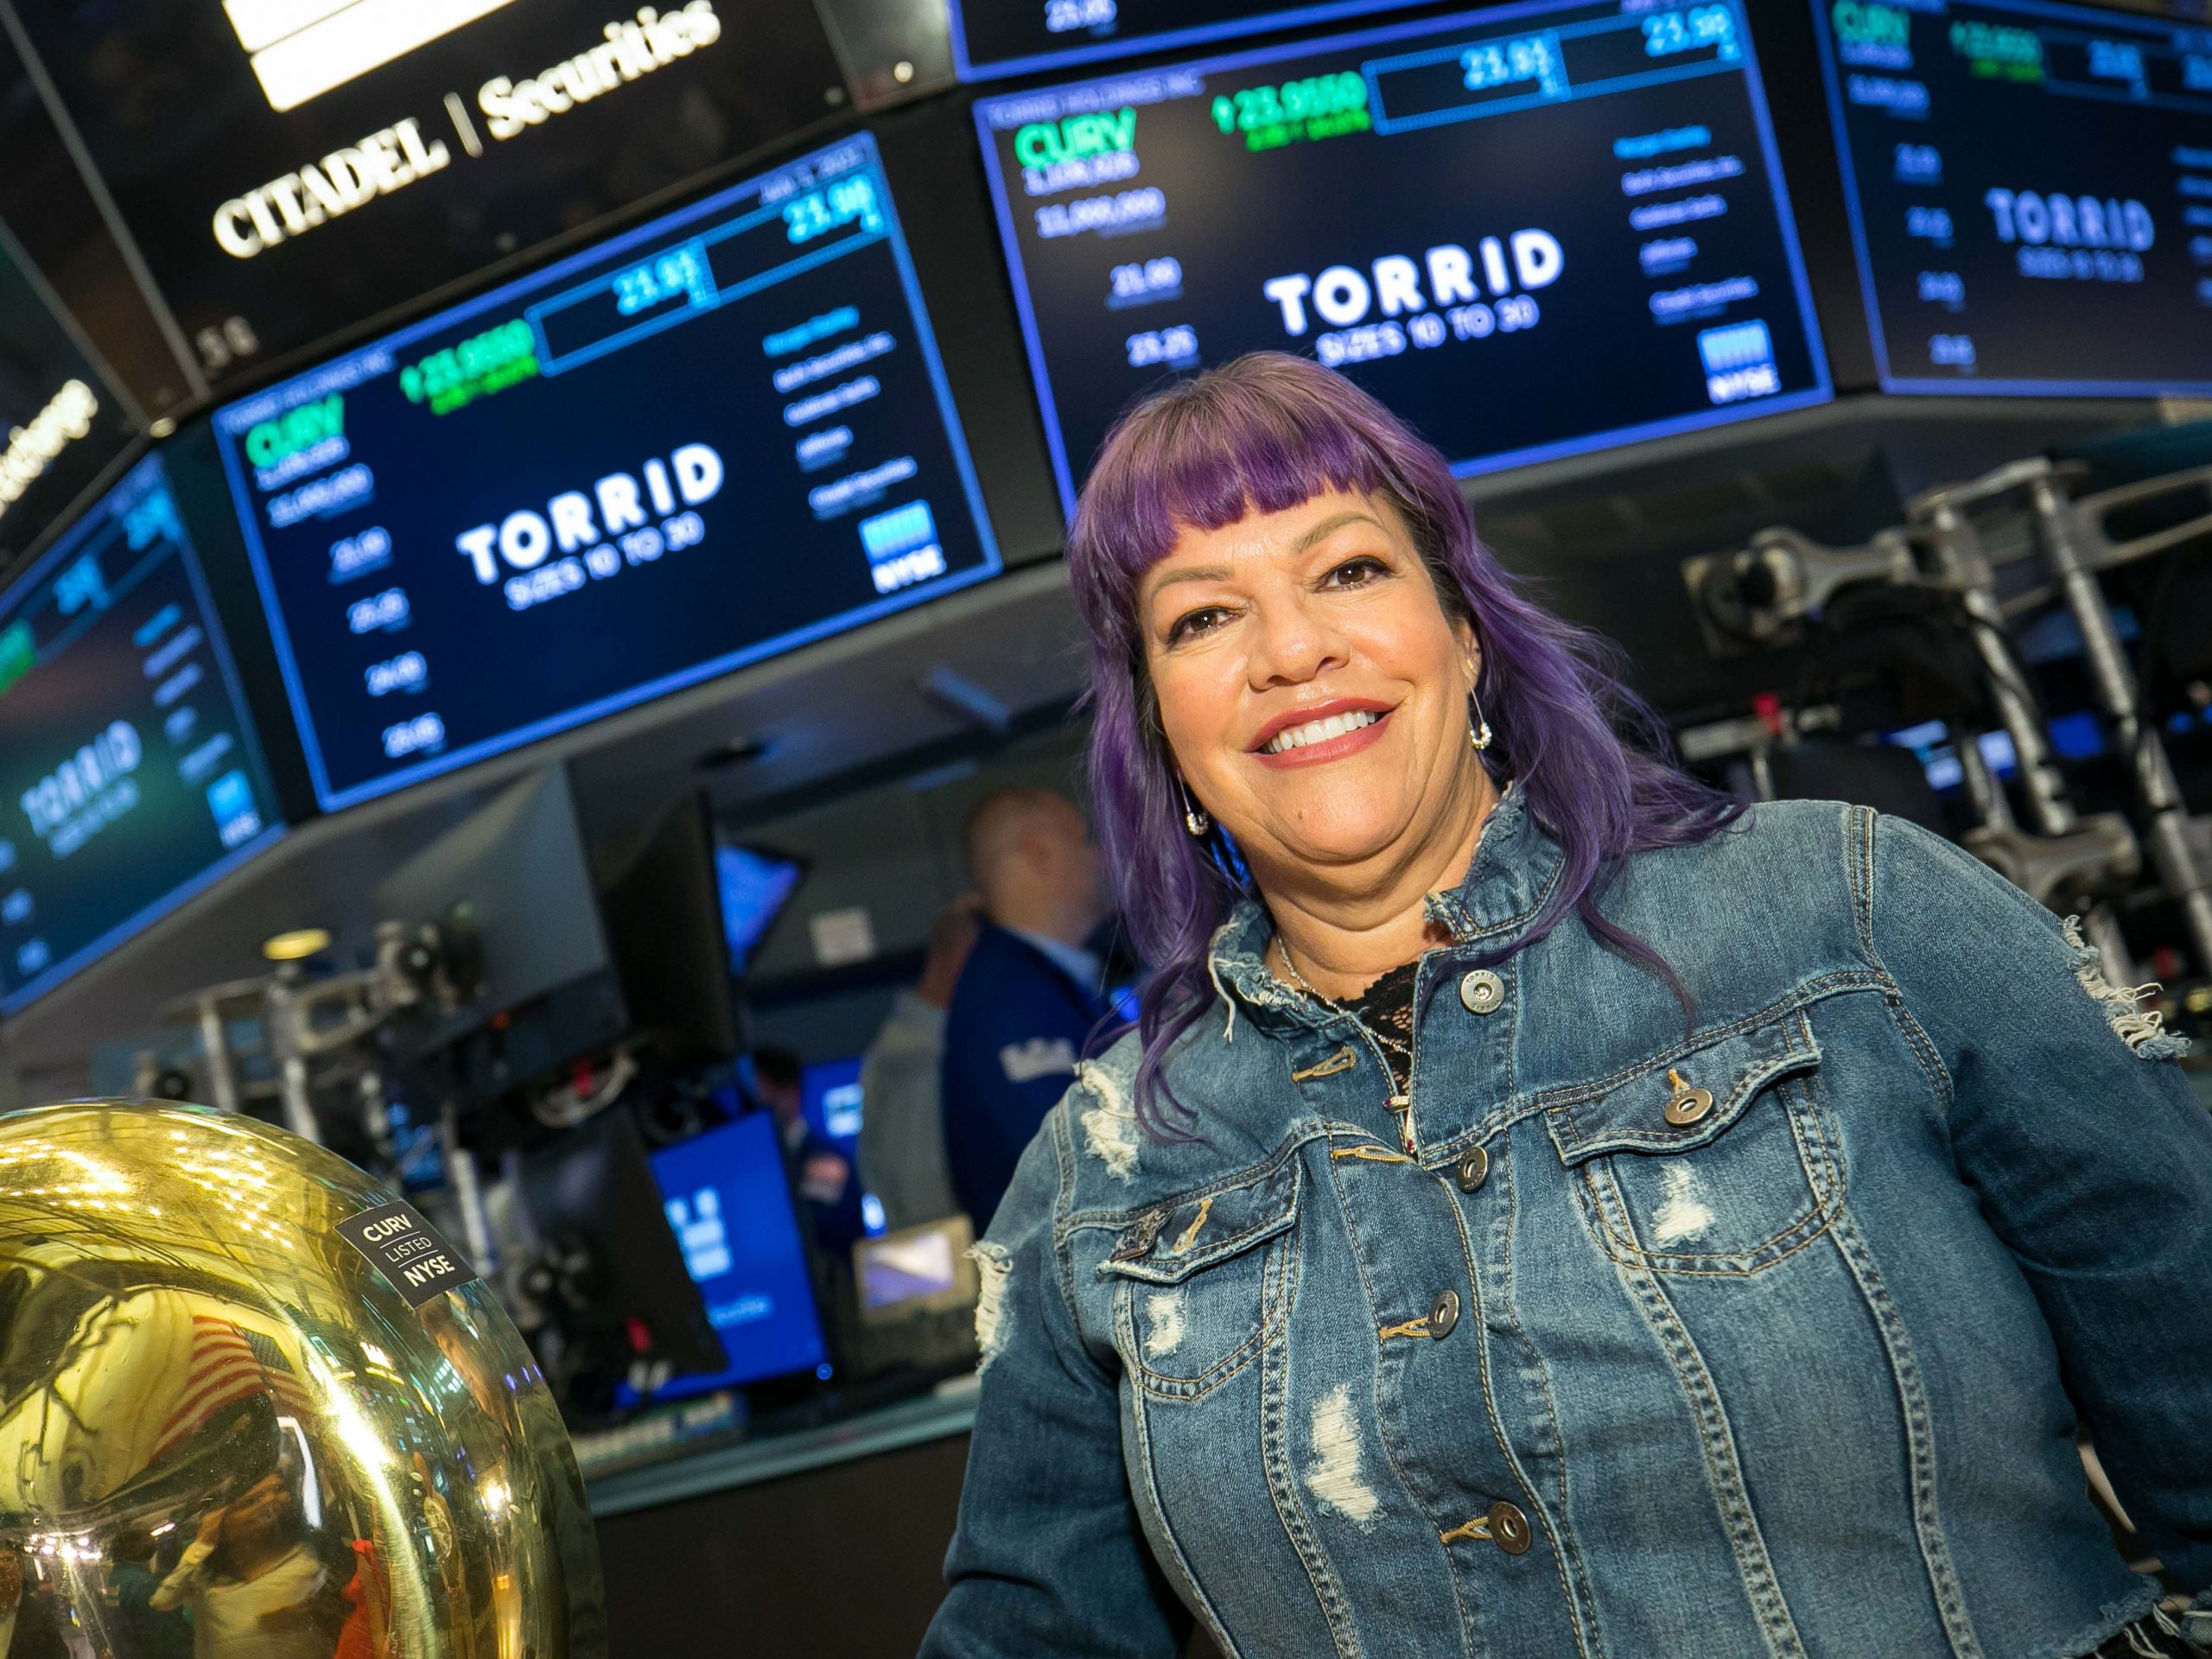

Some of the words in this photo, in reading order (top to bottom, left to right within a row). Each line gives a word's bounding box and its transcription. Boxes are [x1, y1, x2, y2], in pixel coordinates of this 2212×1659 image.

[213, 118, 450, 257] CITADEL
[478, 0, 721, 140] Securities
[1014, 106, 1137, 167] CURV
[1262, 227, 1565, 337] TORRID
[1315, 320, 1407, 367] SIZES
[1406, 312, 1447, 350] 10
[1445, 303, 1496, 341] TO
[1493, 294, 1540, 333] 30
[455, 442, 724, 585] TORRID
[504, 556, 586, 610] SIZES
[584, 543, 621, 580] 10
[617, 526, 664, 566] TO
[660, 511, 705, 551] 30
[363, 1214, 412, 1242] CURV
[385, 1236, 432, 1262] LISTED
[403, 1255, 455, 1287] NYSE
